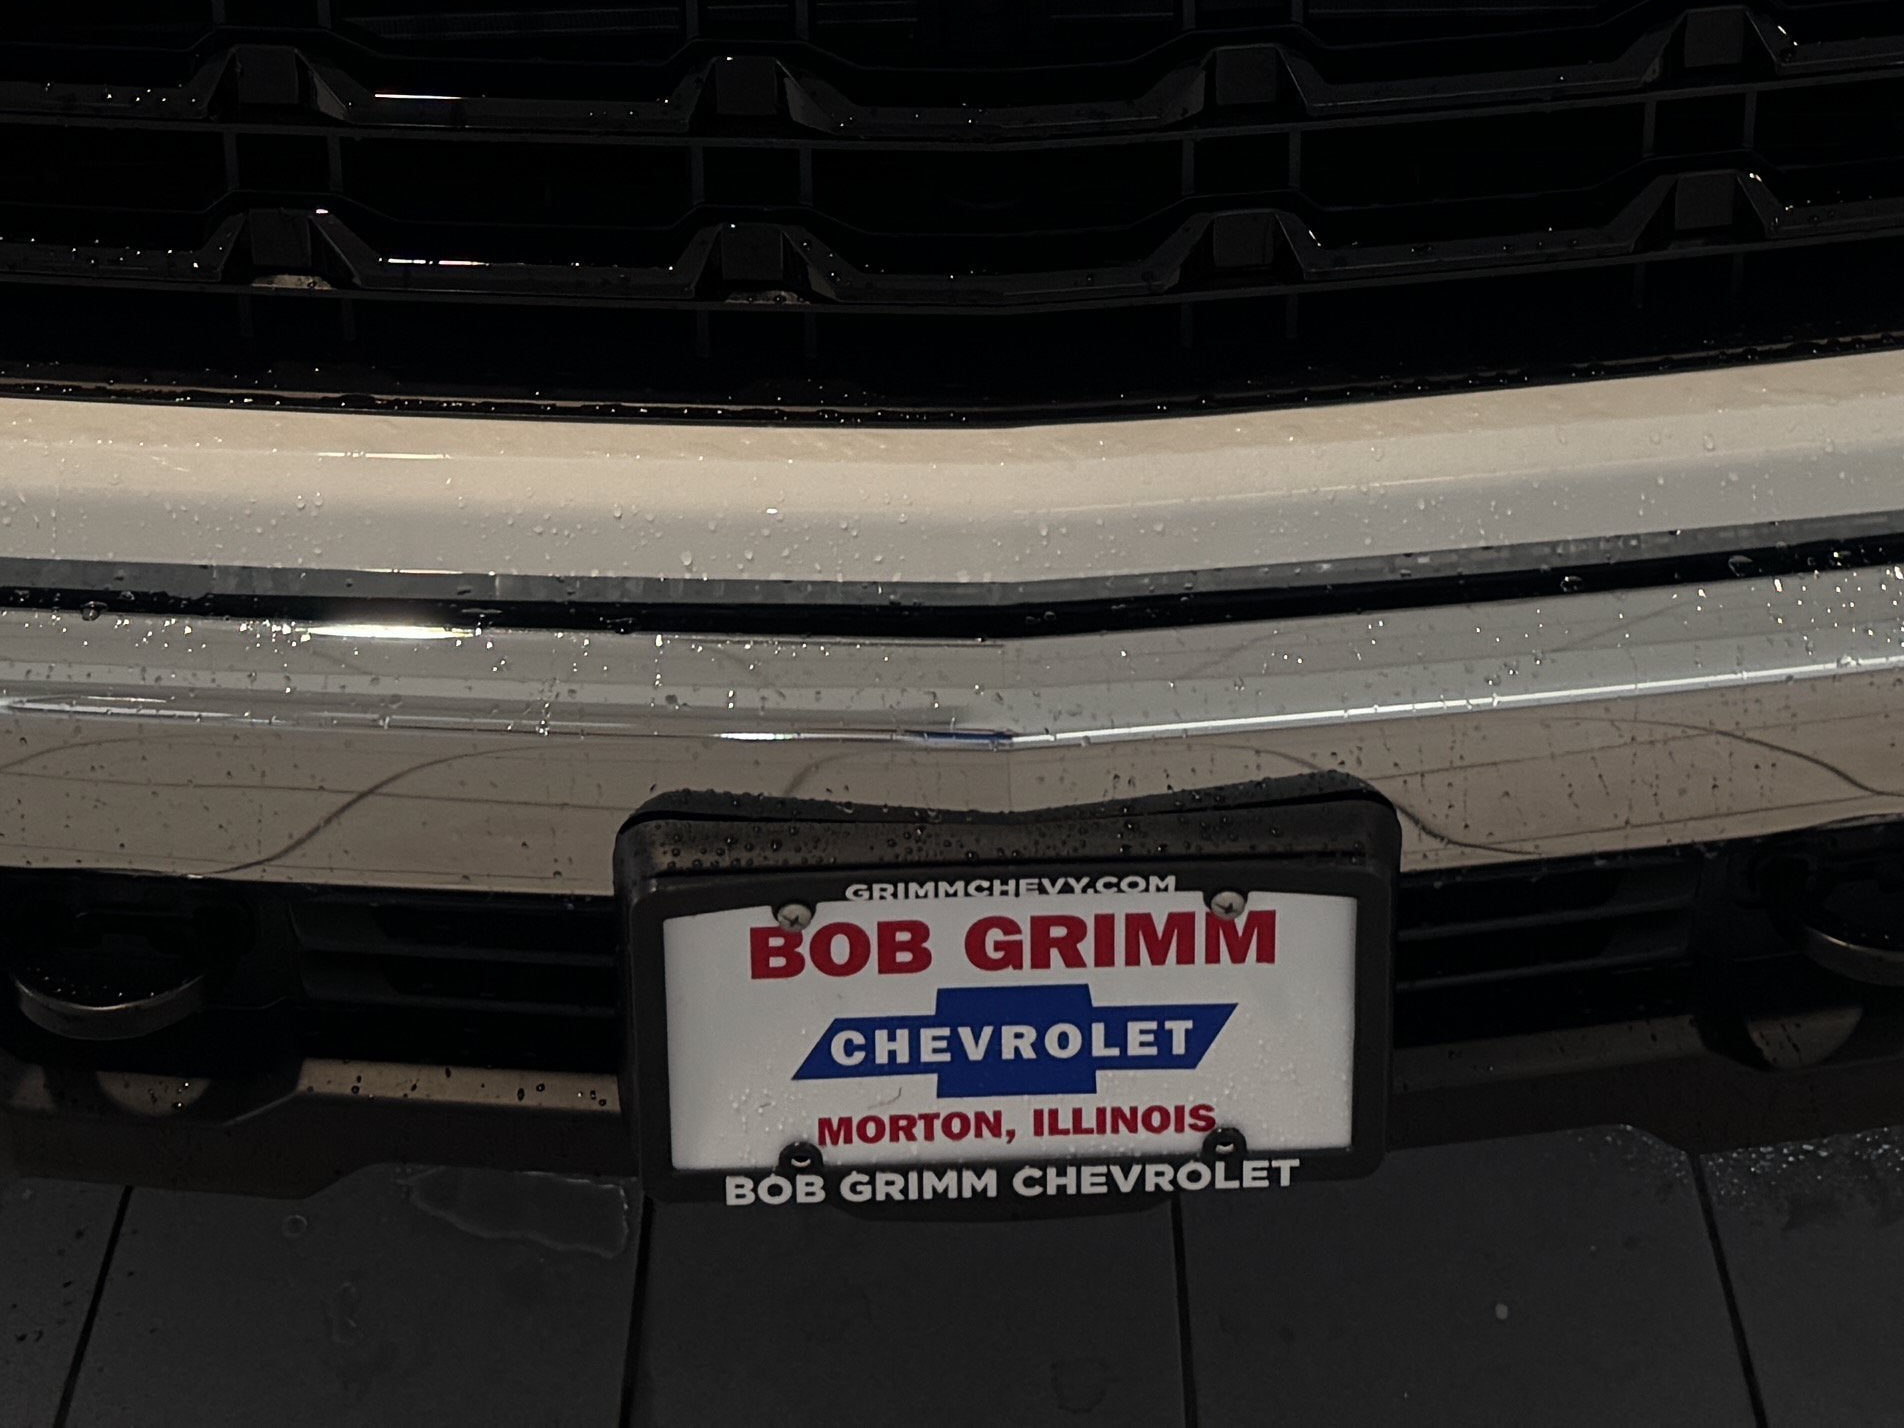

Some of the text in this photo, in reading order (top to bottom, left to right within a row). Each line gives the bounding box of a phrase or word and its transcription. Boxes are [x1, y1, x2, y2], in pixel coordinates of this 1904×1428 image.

[846, 875, 1177, 902] GRIMMCHEVY.COM
[749, 910, 1277, 980] BOB GRIMM
[830, 1019, 1194, 1067] CHEVROLET
[817, 1103, 1216, 1147] MORTON, ILLINOIS
[725, 1158, 1300, 1206] BOB GRIMM CHEVROLET
